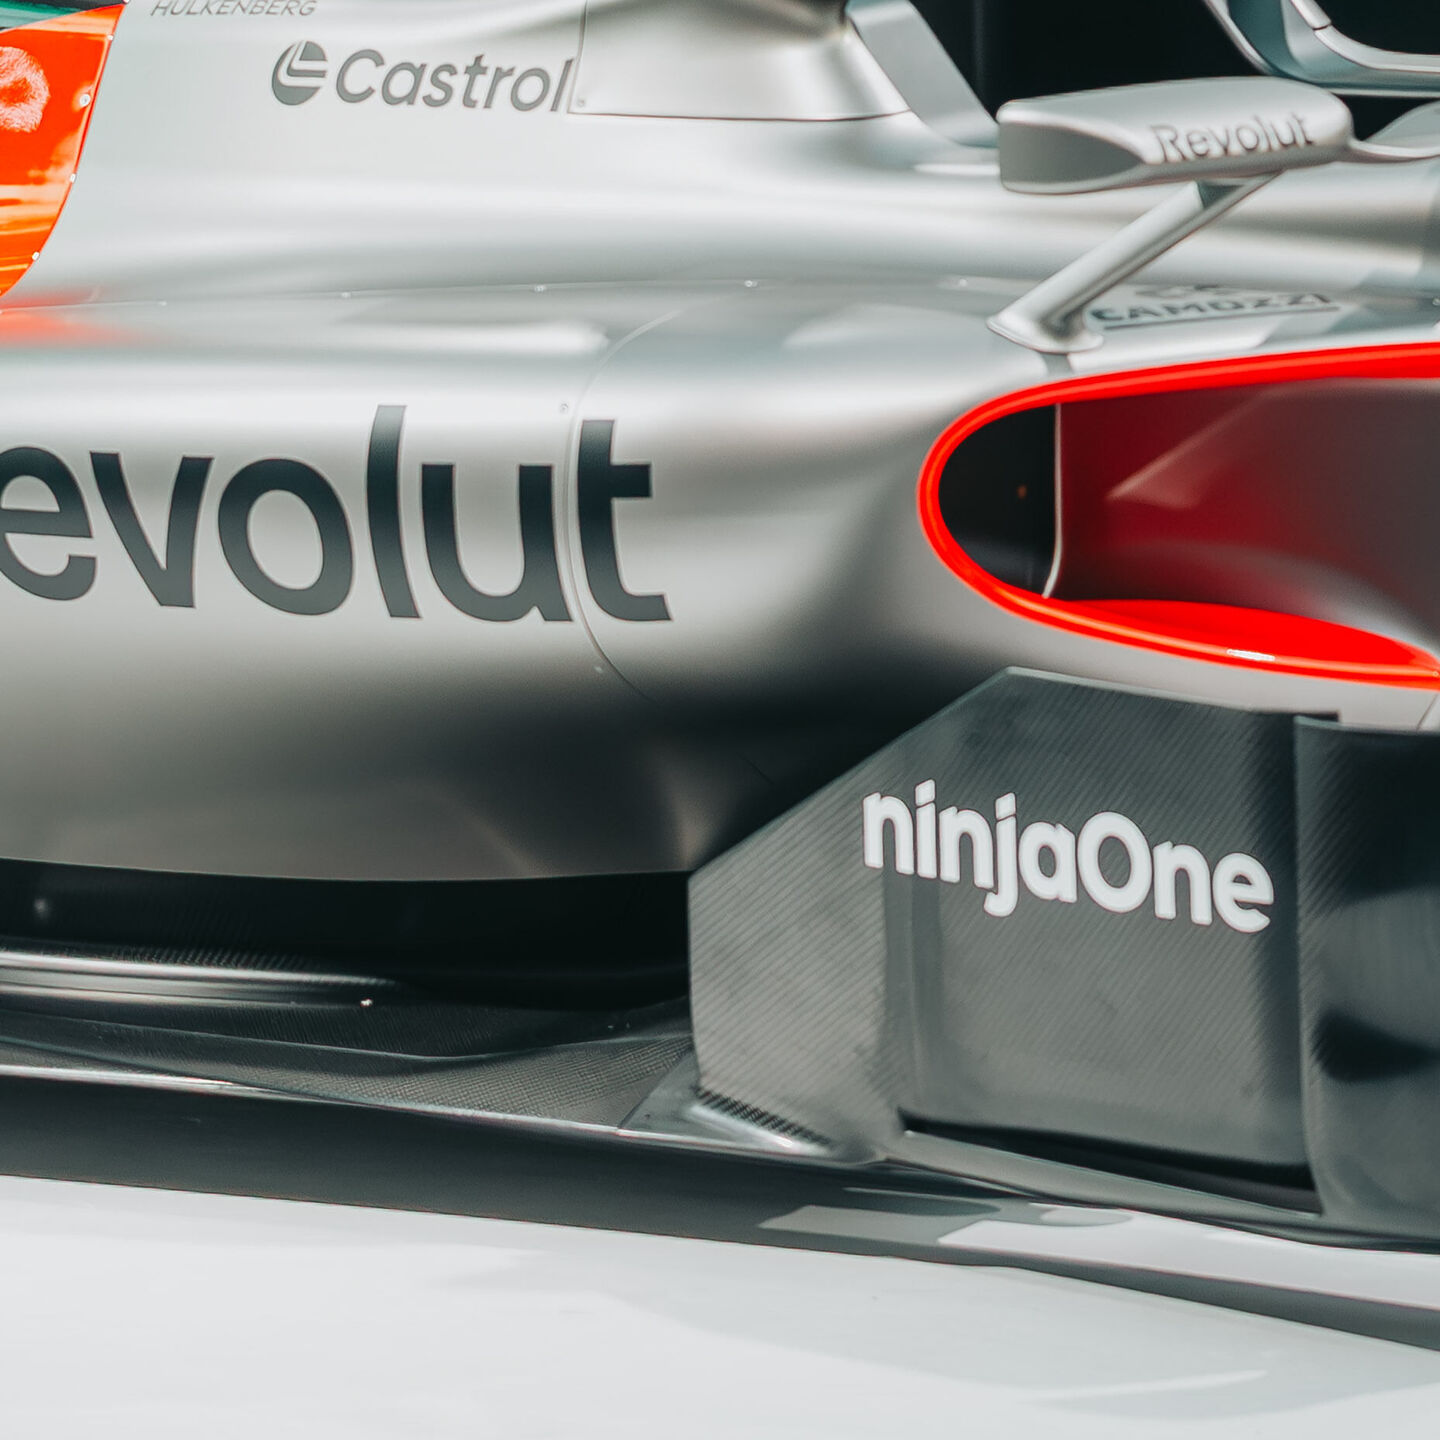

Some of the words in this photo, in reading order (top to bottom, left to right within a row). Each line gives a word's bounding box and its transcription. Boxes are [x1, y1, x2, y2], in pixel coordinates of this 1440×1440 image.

[335, 48, 574, 114] Castrol
[1150, 112, 1315, 163] Revolut
[862, 778, 1276, 933] ninjaOne
